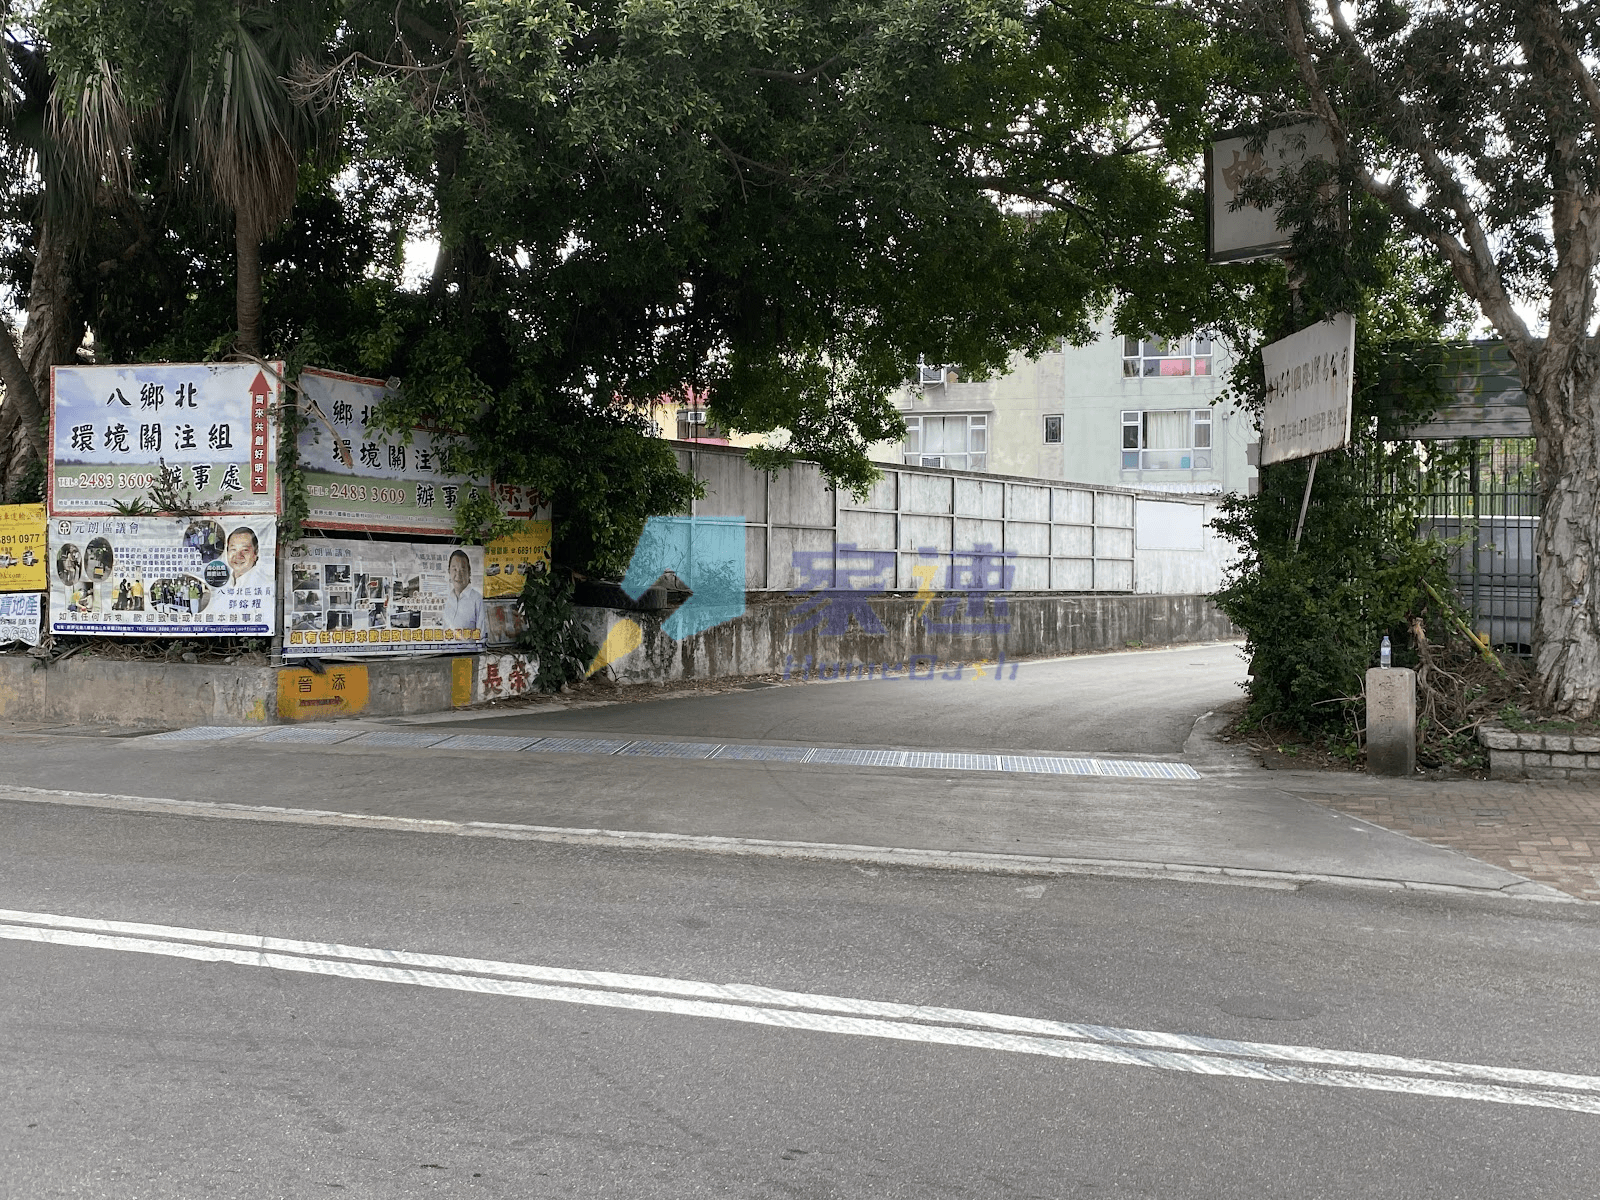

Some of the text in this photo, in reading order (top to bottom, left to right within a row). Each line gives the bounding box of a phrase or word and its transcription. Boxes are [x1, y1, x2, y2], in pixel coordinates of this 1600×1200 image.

[106, 381, 198, 411] 八鄉北
[304, 399, 378, 428] 八鄉北
[71, 423, 233, 452] 環境關注組
[79, 473, 114, 488] 2483
[119, 473, 154, 488] 3609
[162, 464, 244, 492] 辦事處
[330, 483, 367, 501] 2483
[371, 486, 406, 504] 3609
[0, 534, 40, 544] 891 0977
[74, 521, 140, 535] 元朗區議會
